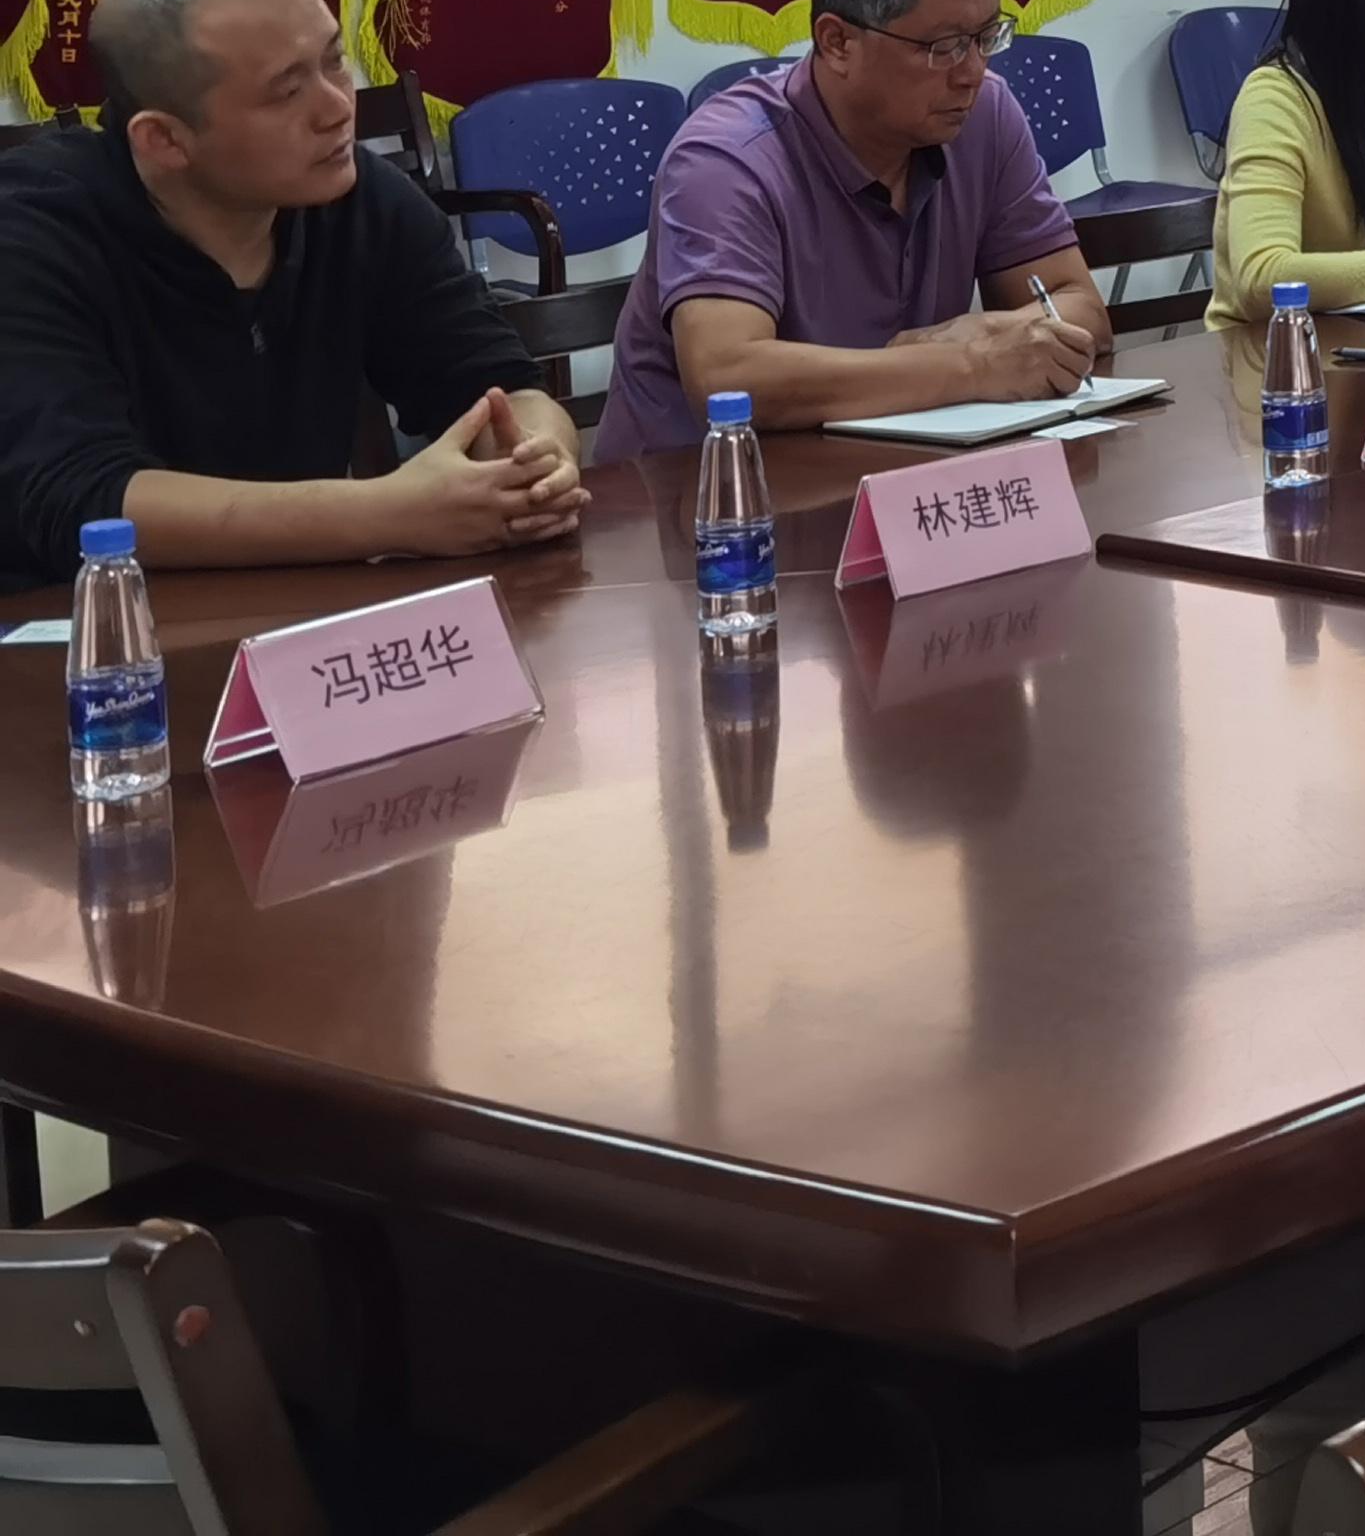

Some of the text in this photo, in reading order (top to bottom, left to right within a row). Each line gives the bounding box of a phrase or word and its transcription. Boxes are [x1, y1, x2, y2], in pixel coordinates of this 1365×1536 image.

[912, 476, 1040, 542] 林建辉
[311, 623, 475, 709] 冯超华
